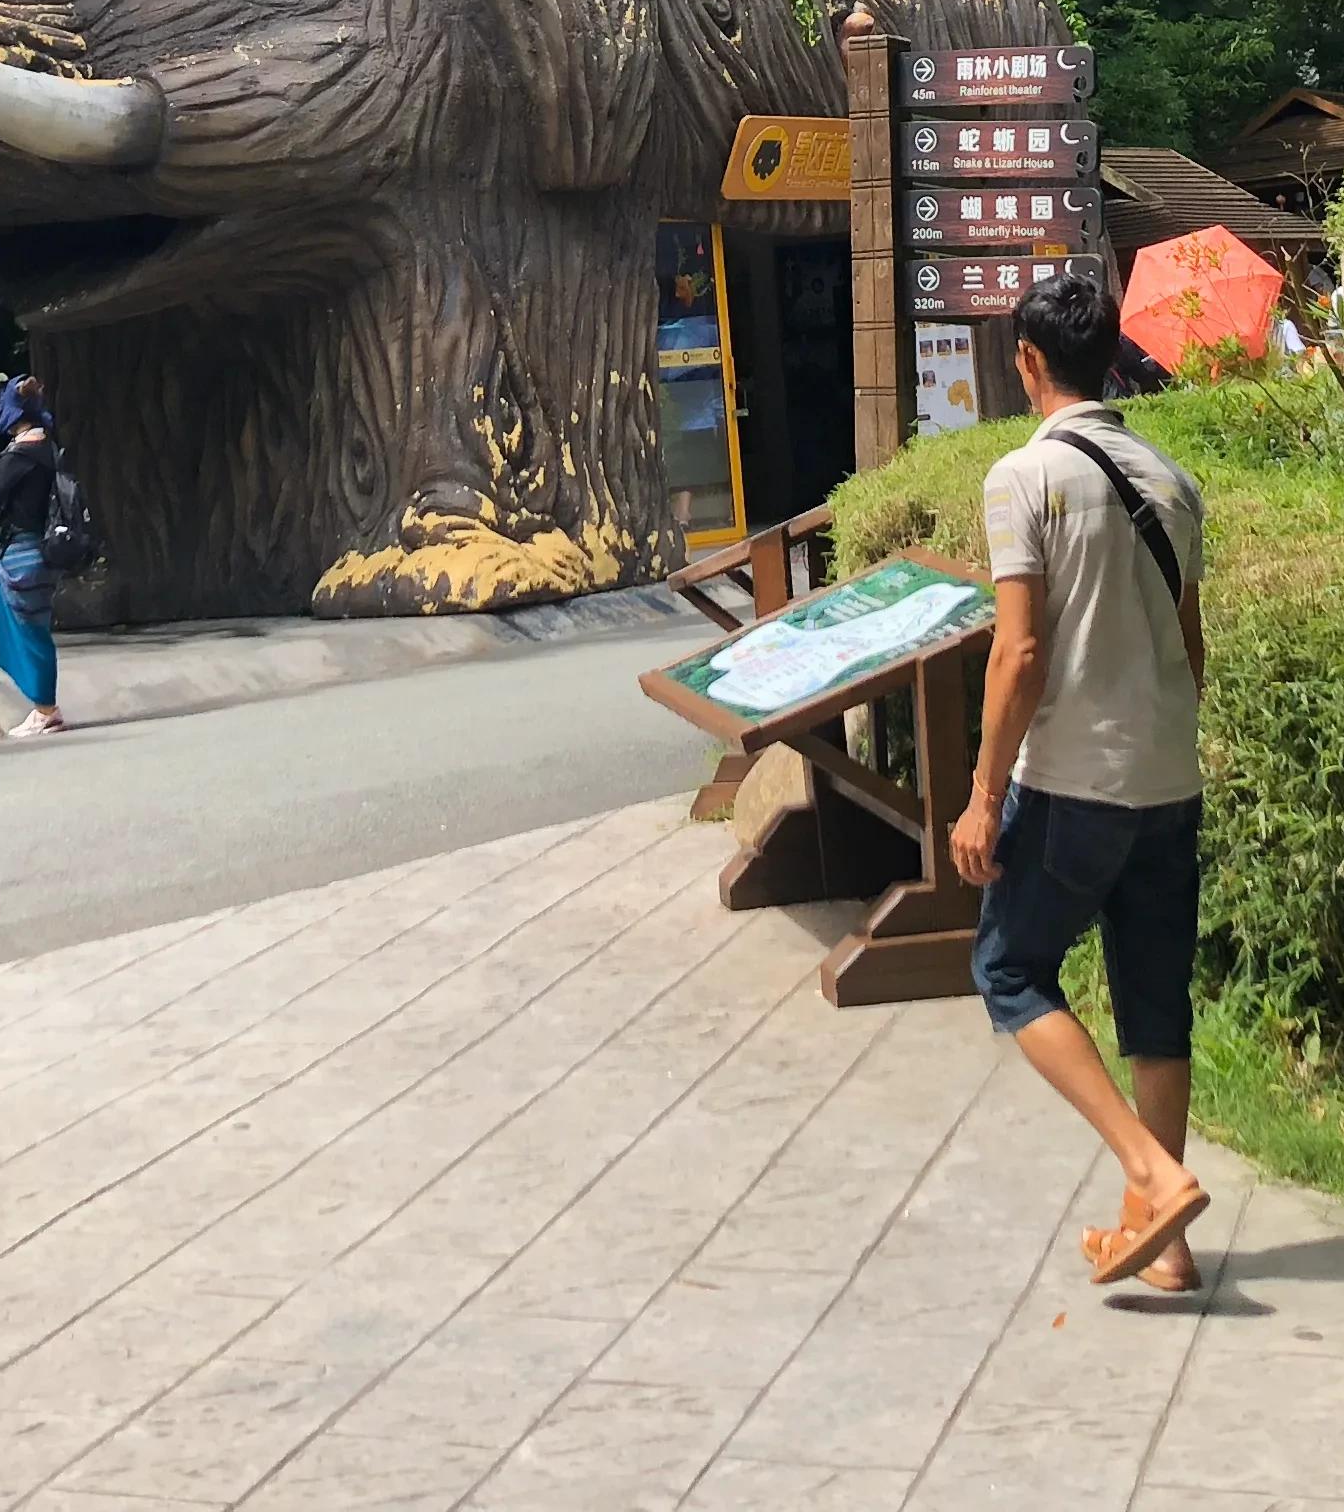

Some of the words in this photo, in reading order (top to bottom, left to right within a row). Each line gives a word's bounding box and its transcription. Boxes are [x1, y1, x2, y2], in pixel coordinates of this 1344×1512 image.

[956, 54, 1047, 81] 雨林小剧场
[912, 89, 936, 100] 45m
[959, 85, 1007, 97] Rainforest
[1008, 84, 1043, 96] theater
[958, 128, 1050, 153] 蛇蜥园
[911, 159, 940, 171] 115m
[953, 157, 983, 169] Snake
[984, 157, 992, 169] &
[993, 157, 1022, 169] Lizard
[1024, 157, 1055, 169] House
[960, 195, 1053, 220] 蝴蝶园
[912, 228, 943, 240] 200m
[968, 225, 1010, 238] Butterfly
[1012, 225, 1046, 237] House
[914, 297, 945, 310] 320m
[970, 295, 1006, 307] Orchid
